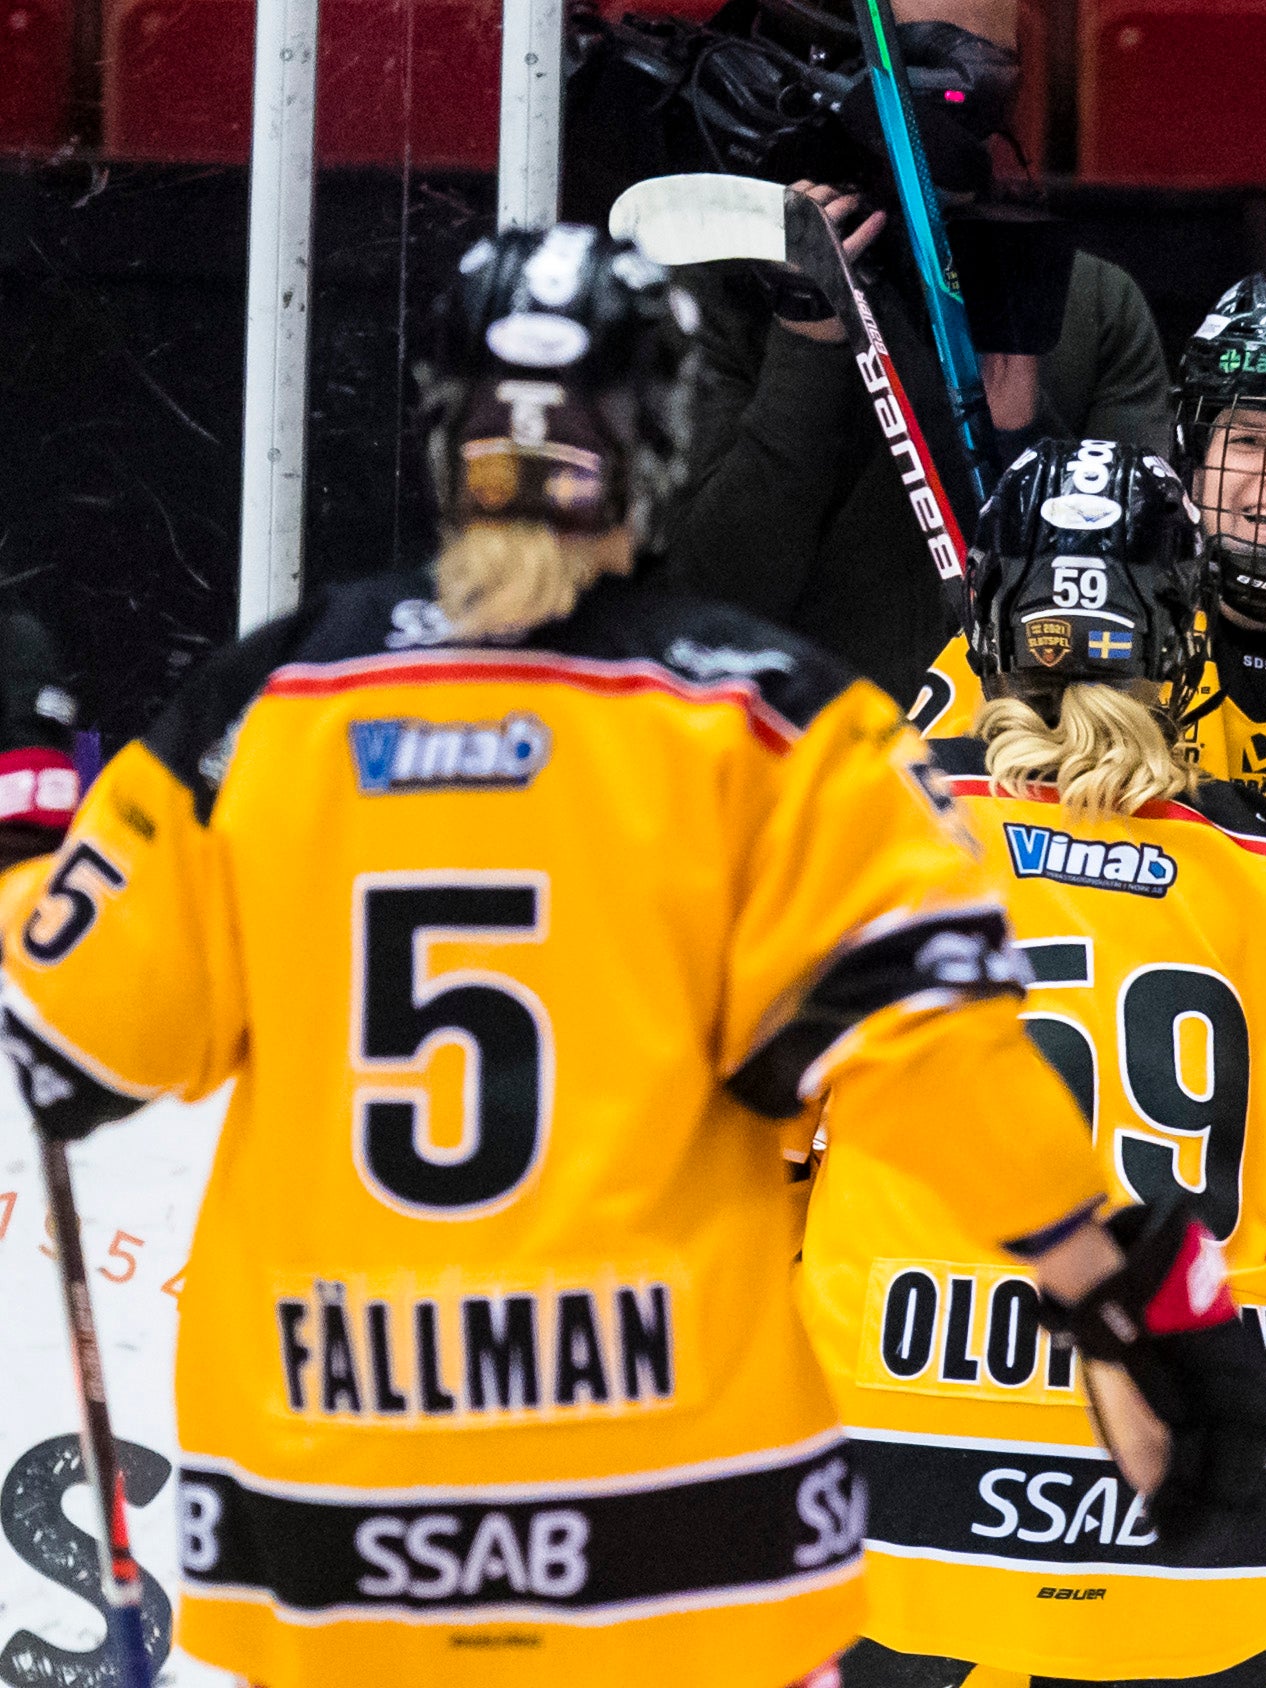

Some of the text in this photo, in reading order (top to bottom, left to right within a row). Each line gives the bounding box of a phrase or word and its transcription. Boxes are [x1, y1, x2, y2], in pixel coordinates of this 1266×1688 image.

[856, 344, 965, 581] BAUER
[1052, 569, 1108, 609] 59
[23, 840, 128, 965] 5
[1005, 824, 1175, 888] Vinab
[354, 872, 554, 1222] 5
[277, 1277, 674, 1415] FÄLLMAN
[355, 1511, 590, 1599] SSAB
[1036, 1586, 1107, 1602] BAUER
